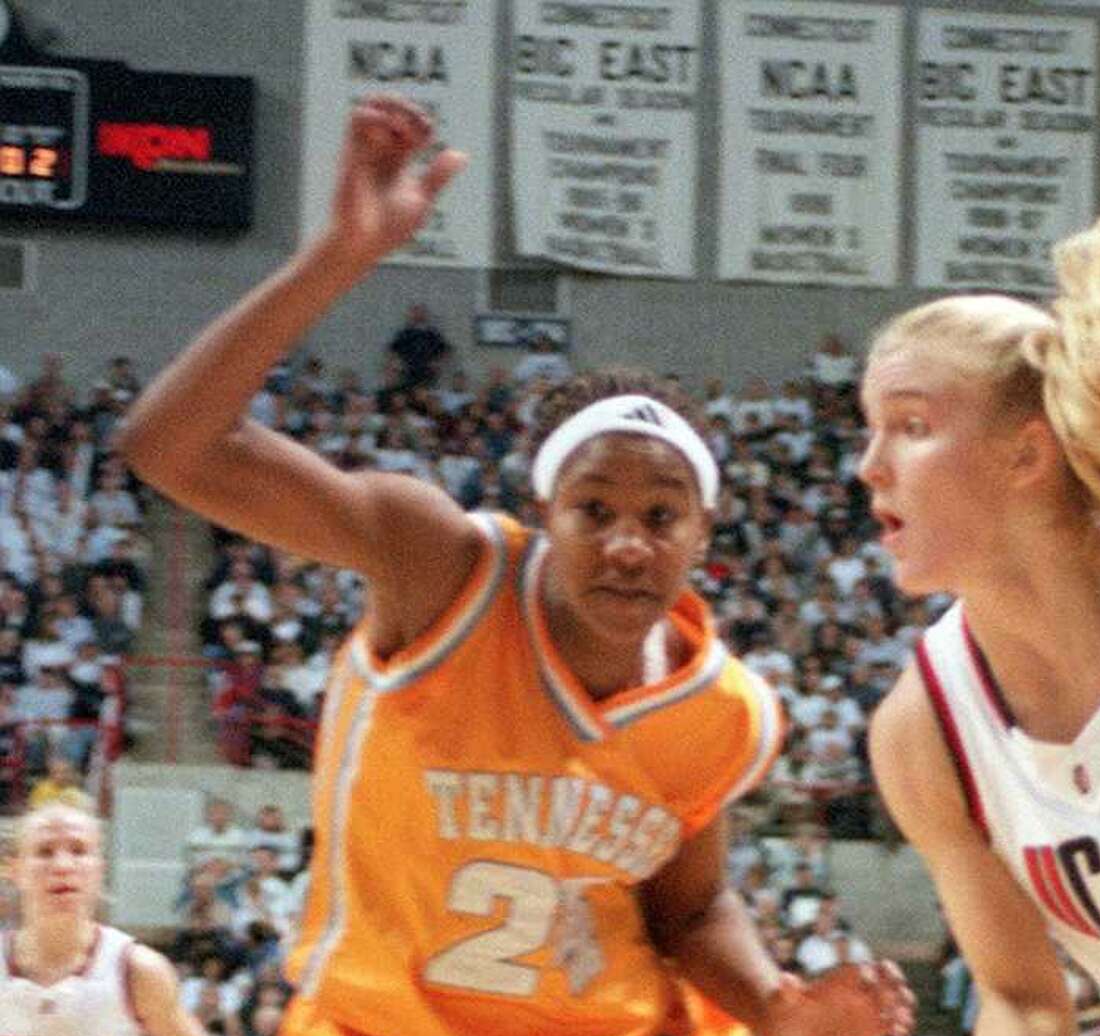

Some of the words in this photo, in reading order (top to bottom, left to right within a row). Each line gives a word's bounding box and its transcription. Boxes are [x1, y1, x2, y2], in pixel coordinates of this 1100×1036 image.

[348, 40, 448, 82] NCAA
[601, 40, 697, 83] EAST
[759, 59, 858, 100] NCAA
[1000, 64, 1093, 106] EAST
[423, 769, 683, 881] TENNESS
